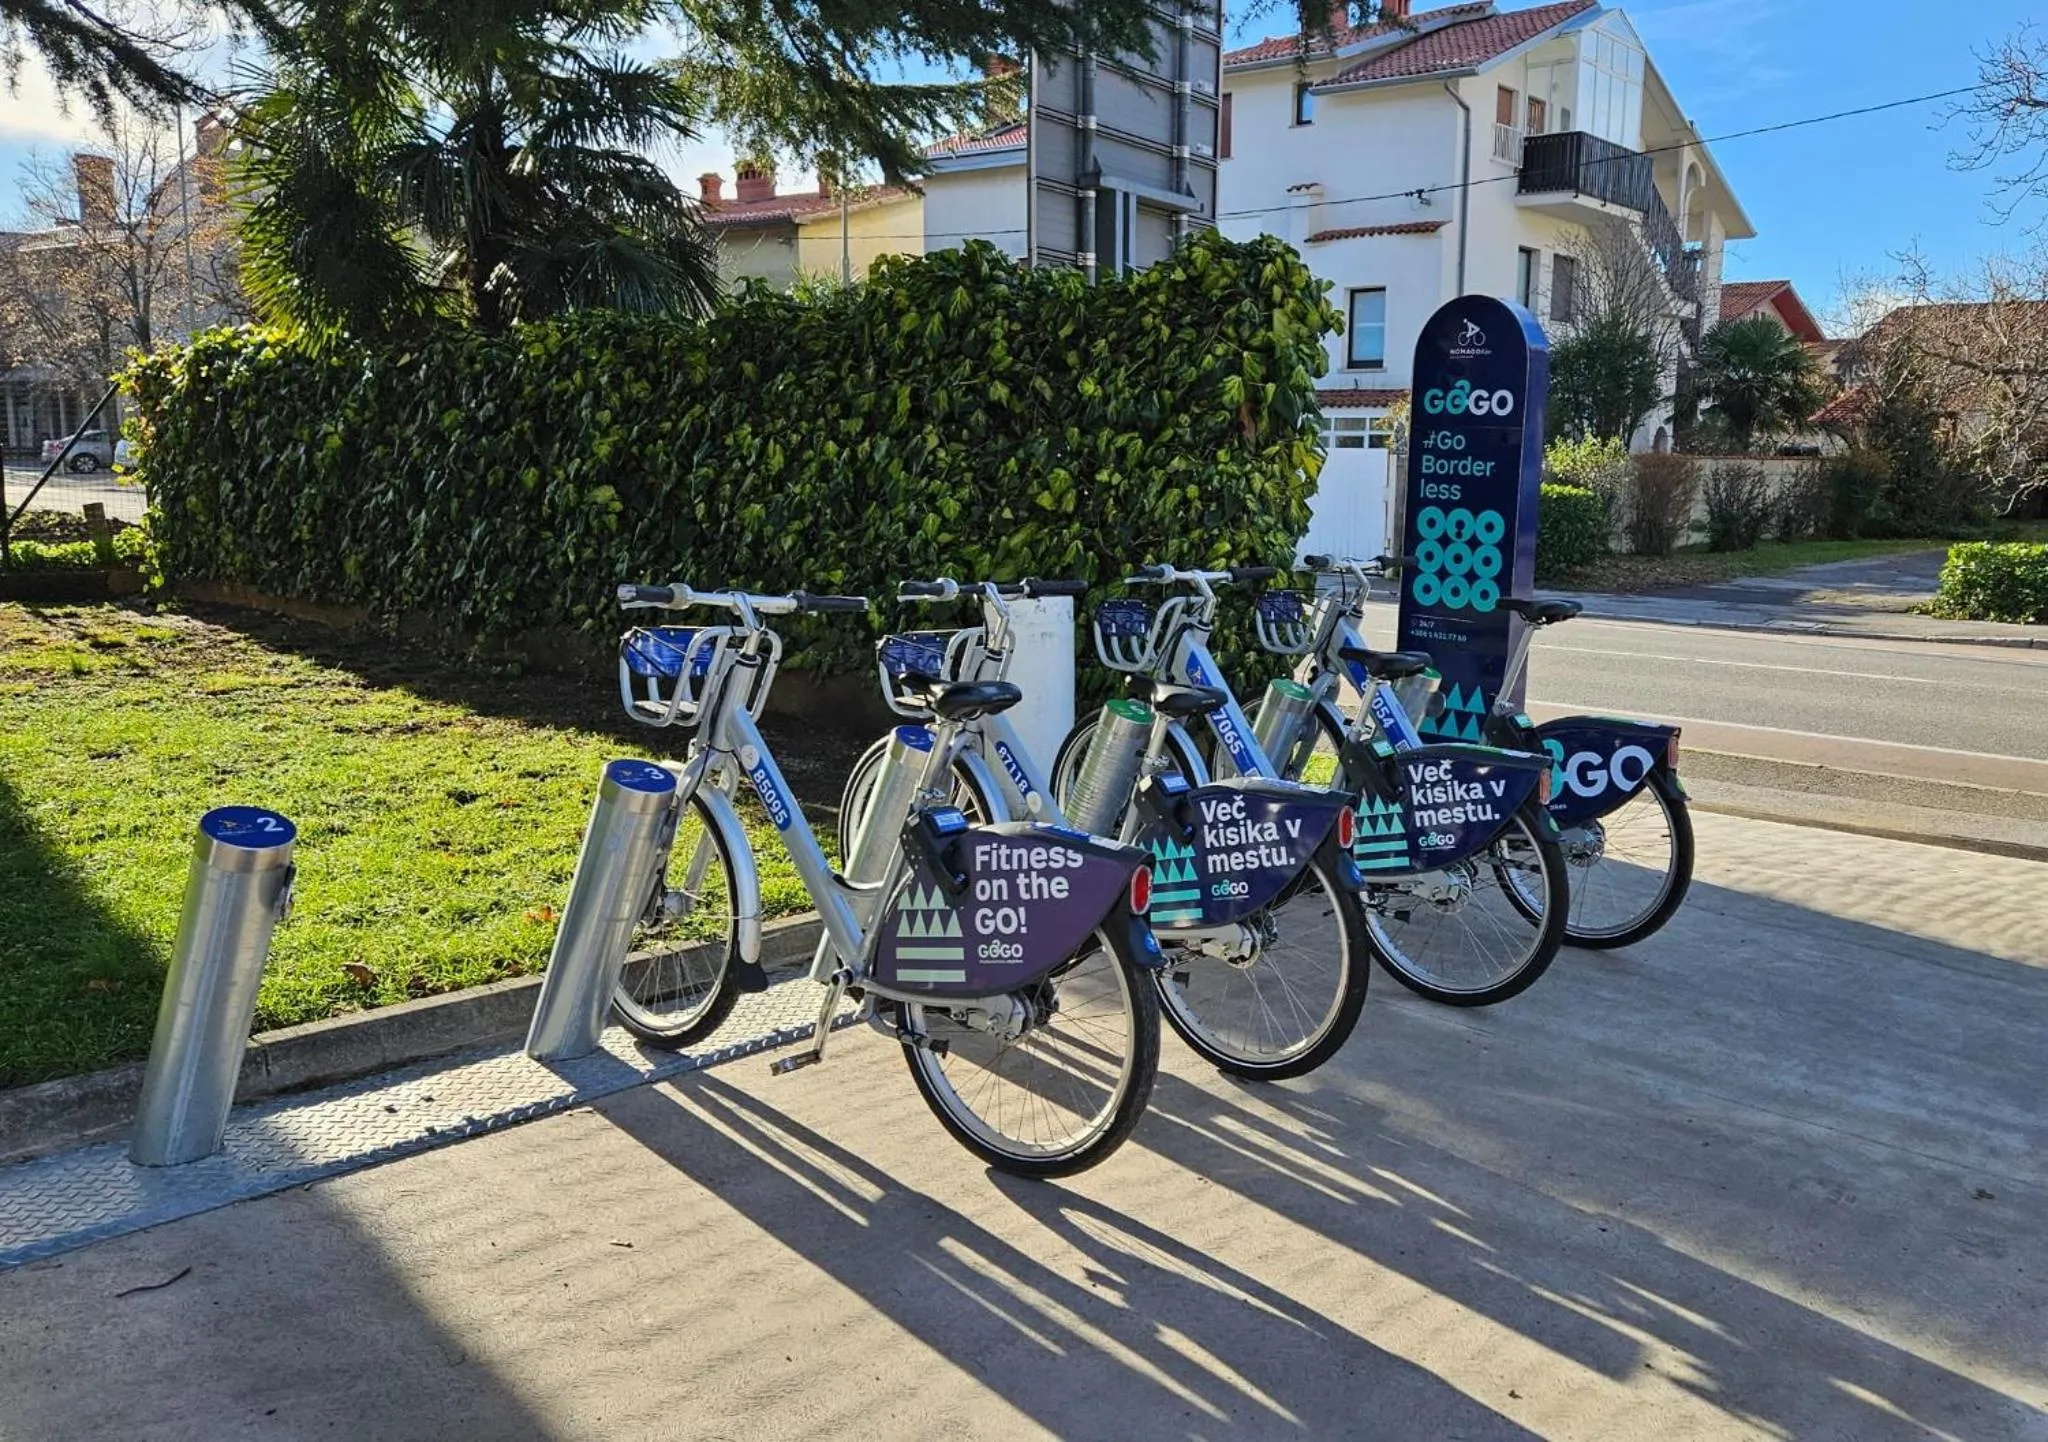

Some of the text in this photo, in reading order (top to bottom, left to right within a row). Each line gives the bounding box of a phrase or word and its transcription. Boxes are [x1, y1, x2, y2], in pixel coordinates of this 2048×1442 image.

[1422, 430, 1466, 450] #Go
[1422, 455, 1495, 476] Border
[1420, 478, 1462, 500] less
[643, 767, 665, 780] 3
[998, 746, 1028, 792] 87118
[1408, 759, 1453, 783] Več
[753, 769, 788, 824] 85095
[1411, 780, 1506, 806] kisika v
[1200, 794, 1246, 824] Več
[1414, 802, 1500, 828] mestu.
[256, 817, 285, 832] 2
[1203, 818, 1302, 849] kisika v
[975, 843, 1084, 872] Fitness
[1207, 845, 1296, 874] mestu.
[975, 871, 1070, 901] on the
[974, 906, 1028, 935] GO!
